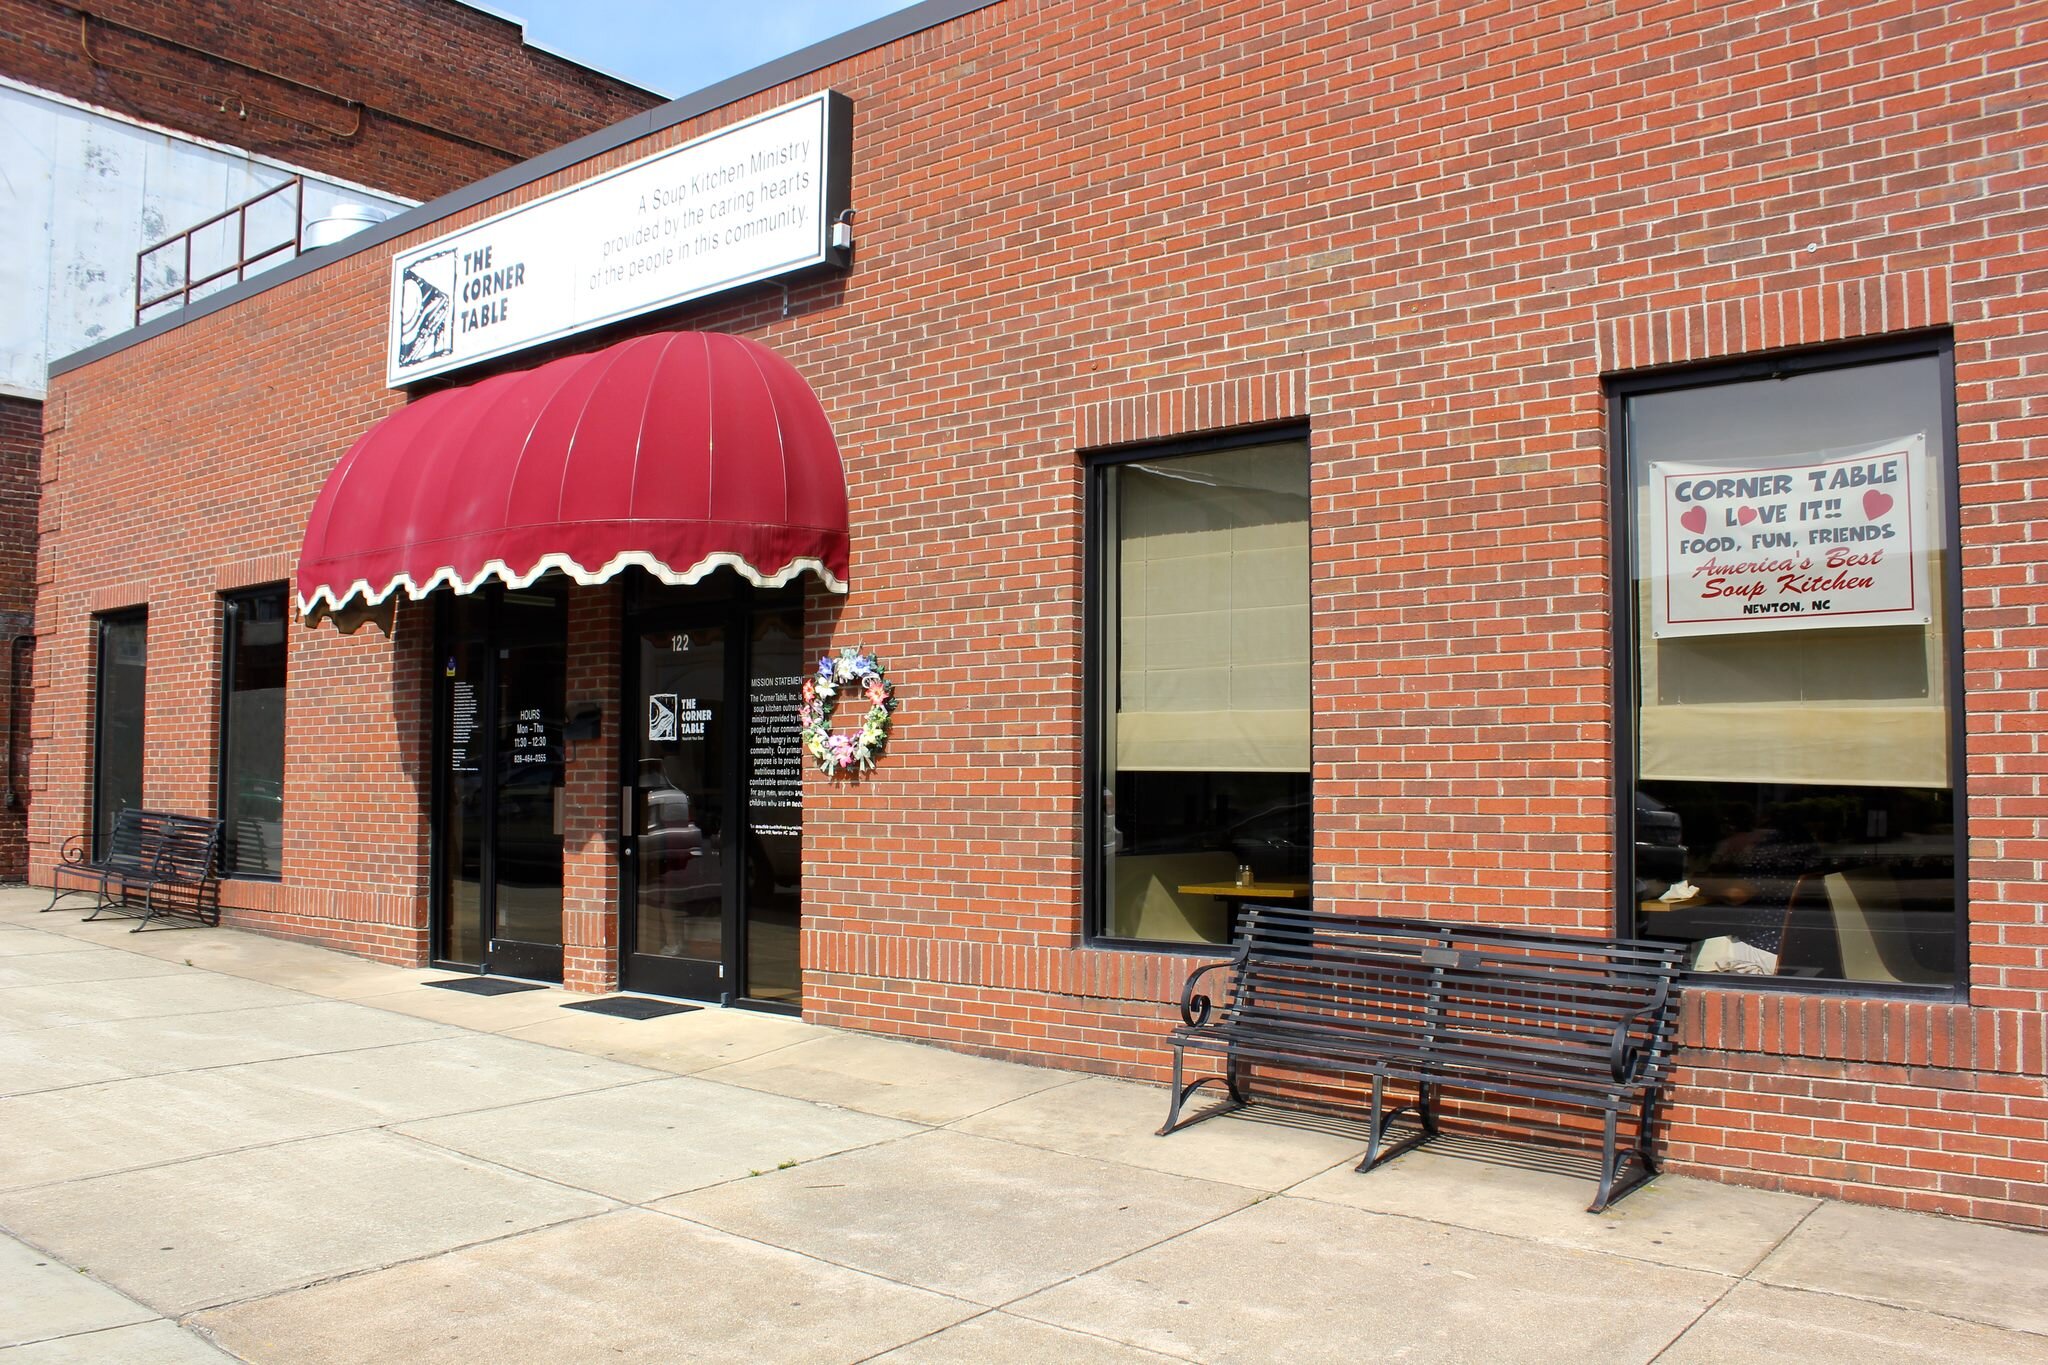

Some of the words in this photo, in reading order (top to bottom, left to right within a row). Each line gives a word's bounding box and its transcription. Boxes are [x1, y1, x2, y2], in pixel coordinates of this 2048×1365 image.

[638, 195, 647, 215] A
[652, 184, 687, 210] Soup
[691, 162, 745, 195] Kitchen
[750, 139, 810, 175] Ministry
[602, 222, 660, 260] provided
[664, 216, 679, 238] by
[682, 208, 704, 230] the
[709, 190, 755, 220] caring
[760, 171, 810, 204] hearts
[589, 270, 602, 290] of
[605, 263, 625, 285] the
[629, 247, 674, 282] people
[678, 240, 690, 261] in
[694, 230, 719, 255] this
[724, 204, 809, 247] community.
[463, 245, 492, 276] THE
[462, 262, 526, 304] CORNER
[461, 297, 508, 334] TABLE
[1674, 474, 1793, 503] CORNER
[1808, 460, 1898, 492] TABLE
[1799, 498, 1842, 522] IT!!
[1680, 536, 1742, 556] FOOD,
[1752, 531, 1799, 551] FUN,
[1809, 523, 1896, 546] FRIENDS
[1691, 551, 1814, 579] America's
[1825, 546, 1885, 569] Best
[1701, 577, 1768, 601] Soup
[1776, 569, 1875, 596] Kitchen
[1743, 601, 1805, 615] NEWTON,
[1811, 600, 1831, 612] NC
[671, 634, 689, 652] 122
[751, 677, 774, 687] MISSION
[774, 676, 803, 686] STATEMEN
[750, 693, 759, 702] The
[788, 692, 798, 701] Inc.
[681, 698, 697, 710] THE
[753, 704, 765, 714] soup
[765, 703, 782, 712] kitchen
[520, 709, 541, 720] HOURS
[681, 709, 713, 722] CORNER
[751, 714, 769, 724] ministry
[769, 714, 790, 724] provided
[790, 713, 797, 724] by
[516, 723, 529, 734] Mon
[533, 722, 544, 733] Thu
[681, 722, 705, 734] TABLE
[750, 725, 766, 735] people
[766, 724, 772, 733] of
[772, 725, 780, 733] our
[514, 737, 528, 748] 11:30
[532, 736, 547, 747] 12:30
[755, 735, 763, 744] for
[762, 735, 770, 744] the
[770, 734, 786, 746] hungry
[791, 736, 800, 744] our
[777, 745, 786, 755] Our
[753, 756, 772, 766] purpose
[777, 756, 783, 765] to
[783, 755, 801, 766] provide
[749, 777, 776, 786] comfortable
[748, 798, 767, 807] children
